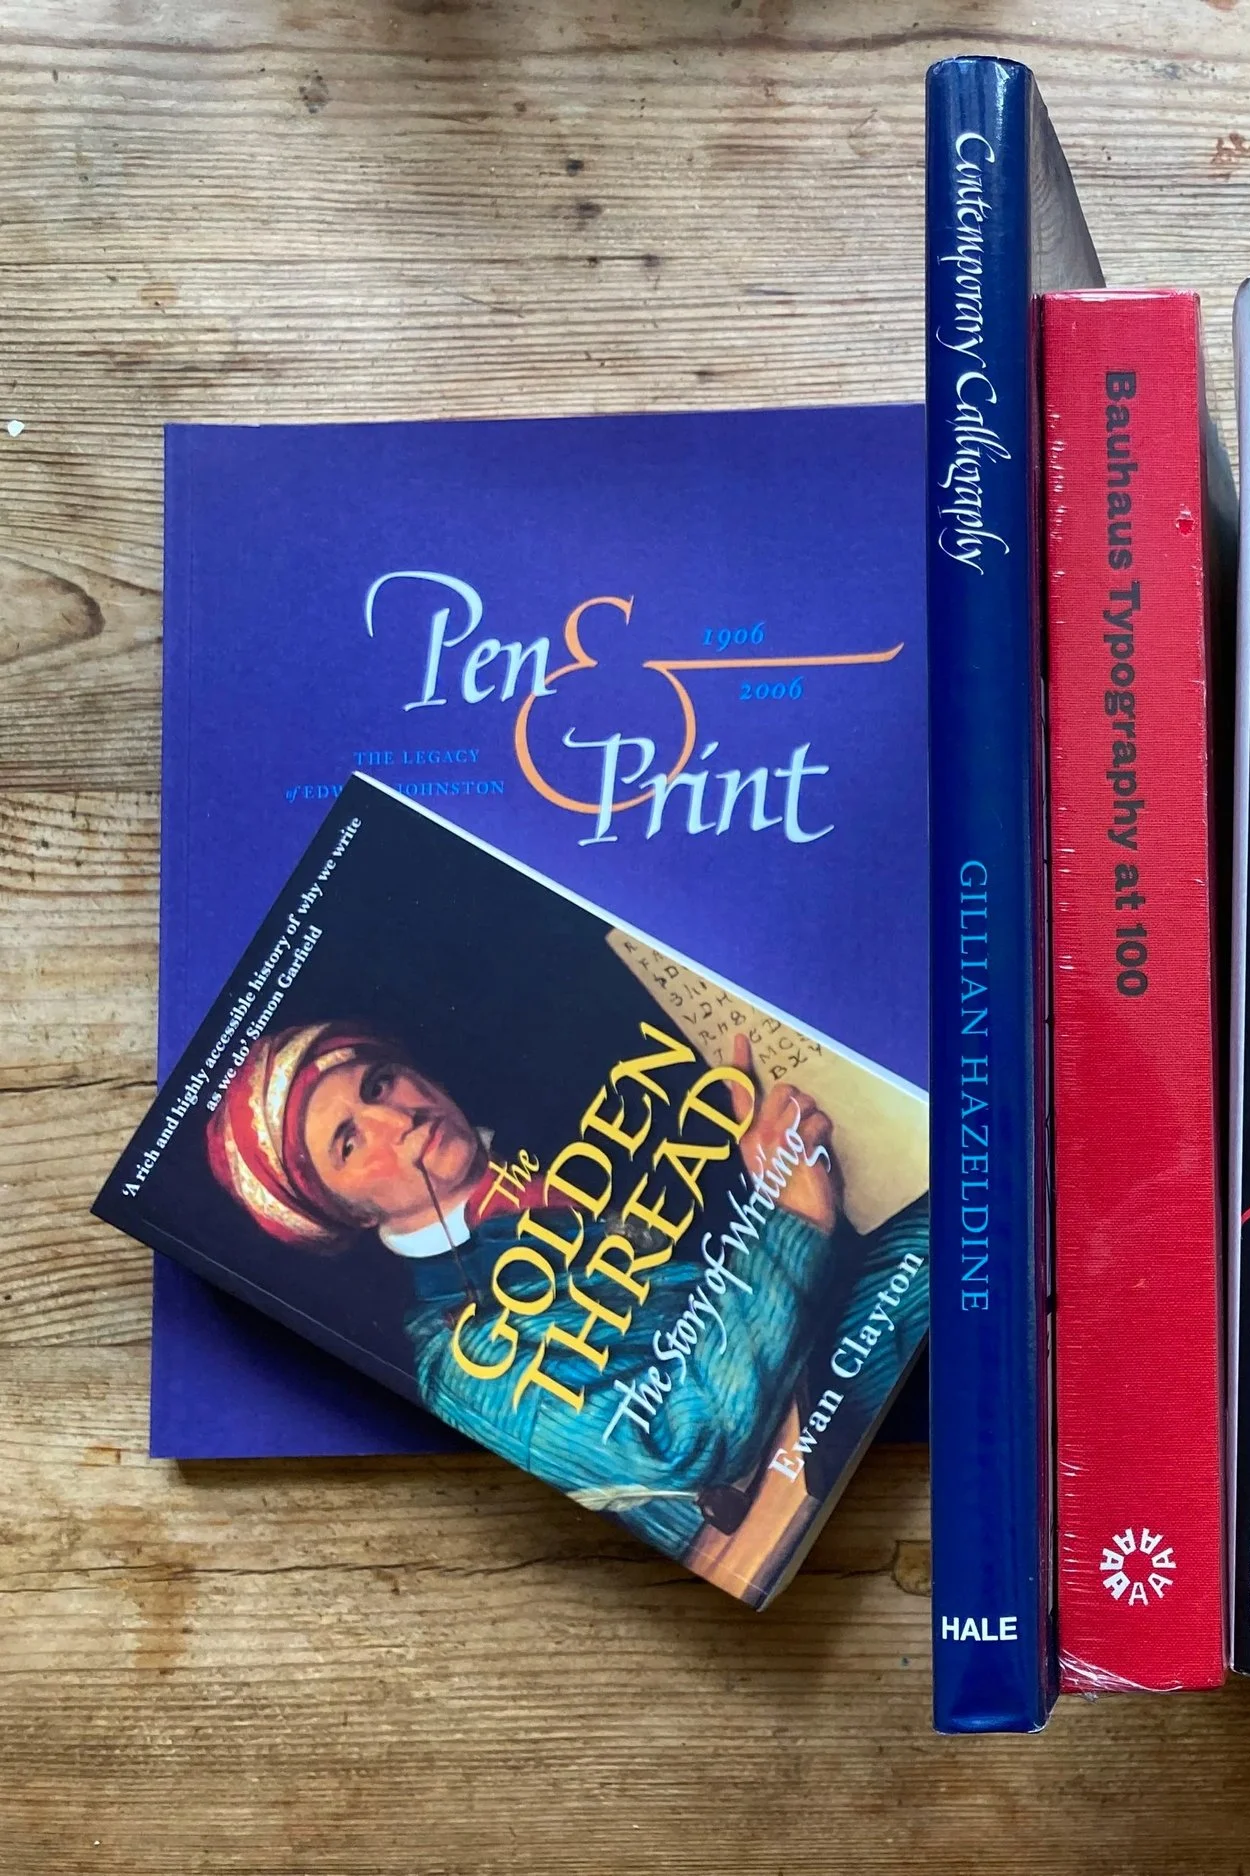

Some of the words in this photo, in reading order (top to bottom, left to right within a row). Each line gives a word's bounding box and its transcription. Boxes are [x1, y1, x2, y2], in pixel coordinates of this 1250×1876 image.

[936, 132, 995, 368] Contemporary
[937, 371, 1012, 576] Calligraphy
[1104, 370, 1138, 571] Bauhaus
[363, 570, 557, 712] Pen
[515, 594, 905, 814] &
[703, 622, 765, 650] 1906
[740, 676, 804, 701] 2006
[1102, 579, 1145, 852] Typography
[286, 785, 301, 803] of
[354, 751, 394, 765] THE
[403, 749, 479, 764] LEGACY
[563, 726, 835, 847] Print
[960, 860, 988, 1037] GILLIAN
[1114, 862, 1147, 910] at
[1115, 922, 1149, 997] 100
[135, 1148, 161, 1186] rich
[155, 1117, 180, 1150] and
[171, 1068, 210, 1127] highly
[204, 993, 256, 1069] accessible
[253, 936, 291, 994] history
[287, 913, 301, 935] of
[297, 882, 324, 915] why
[317, 858, 336, 882] we
[332, 816, 362, 860] write
[206, 1091, 222, 1112] as
[219, 1066, 237, 1092] we
[250, 990, 283, 1040] Simon
[277, 926, 323, 990] Garfield
[451, 1022, 700, 1383] GOLDEN
[478, 1147, 540, 1219] The
[513, 1065, 756, 1413] THREAD
[721, 1096, 831, 1255] Writing
[961, 1055, 989, 1311] HAZELDINE
[653, 1285, 728, 1384] Story
[701, 1232, 753, 1295] of
[603, 1366, 672, 1445] The
[767, 1389, 844, 1483] Ewan
[831, 1251, 922, 1379] Clayton
[942, 1616, 1018, 1642] HALE
